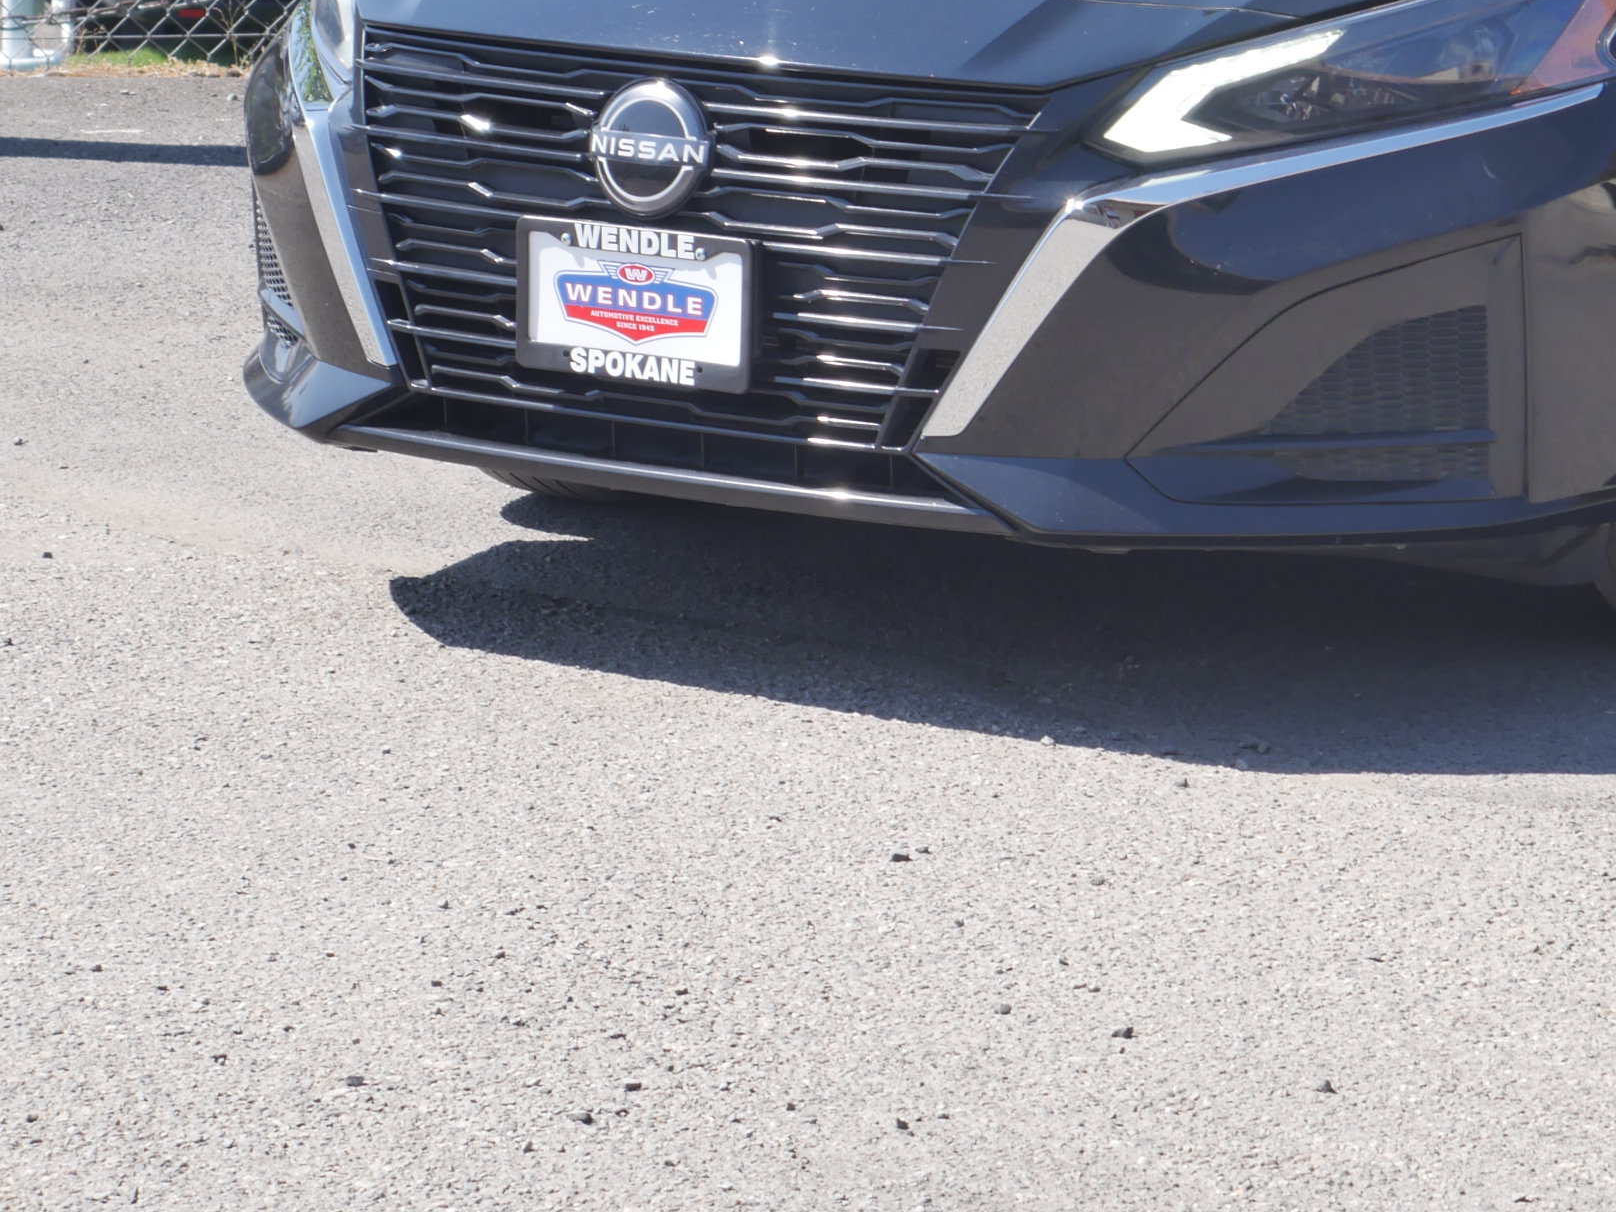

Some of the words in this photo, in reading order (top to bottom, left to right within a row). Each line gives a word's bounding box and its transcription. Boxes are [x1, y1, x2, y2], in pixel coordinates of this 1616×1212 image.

[591, 133, 705, 164] NISSAN
[574, 223, 696, 260] WENDLE
[565, 282, 703, 316] WENDLE
[590, 309, 634, 322] AUTOMOTIVE
[635, 314, 679, 327] EXCELLENCE
[616, 321, 637, 330] SINCE
[569, 346, 695, 386] SPOKANE
